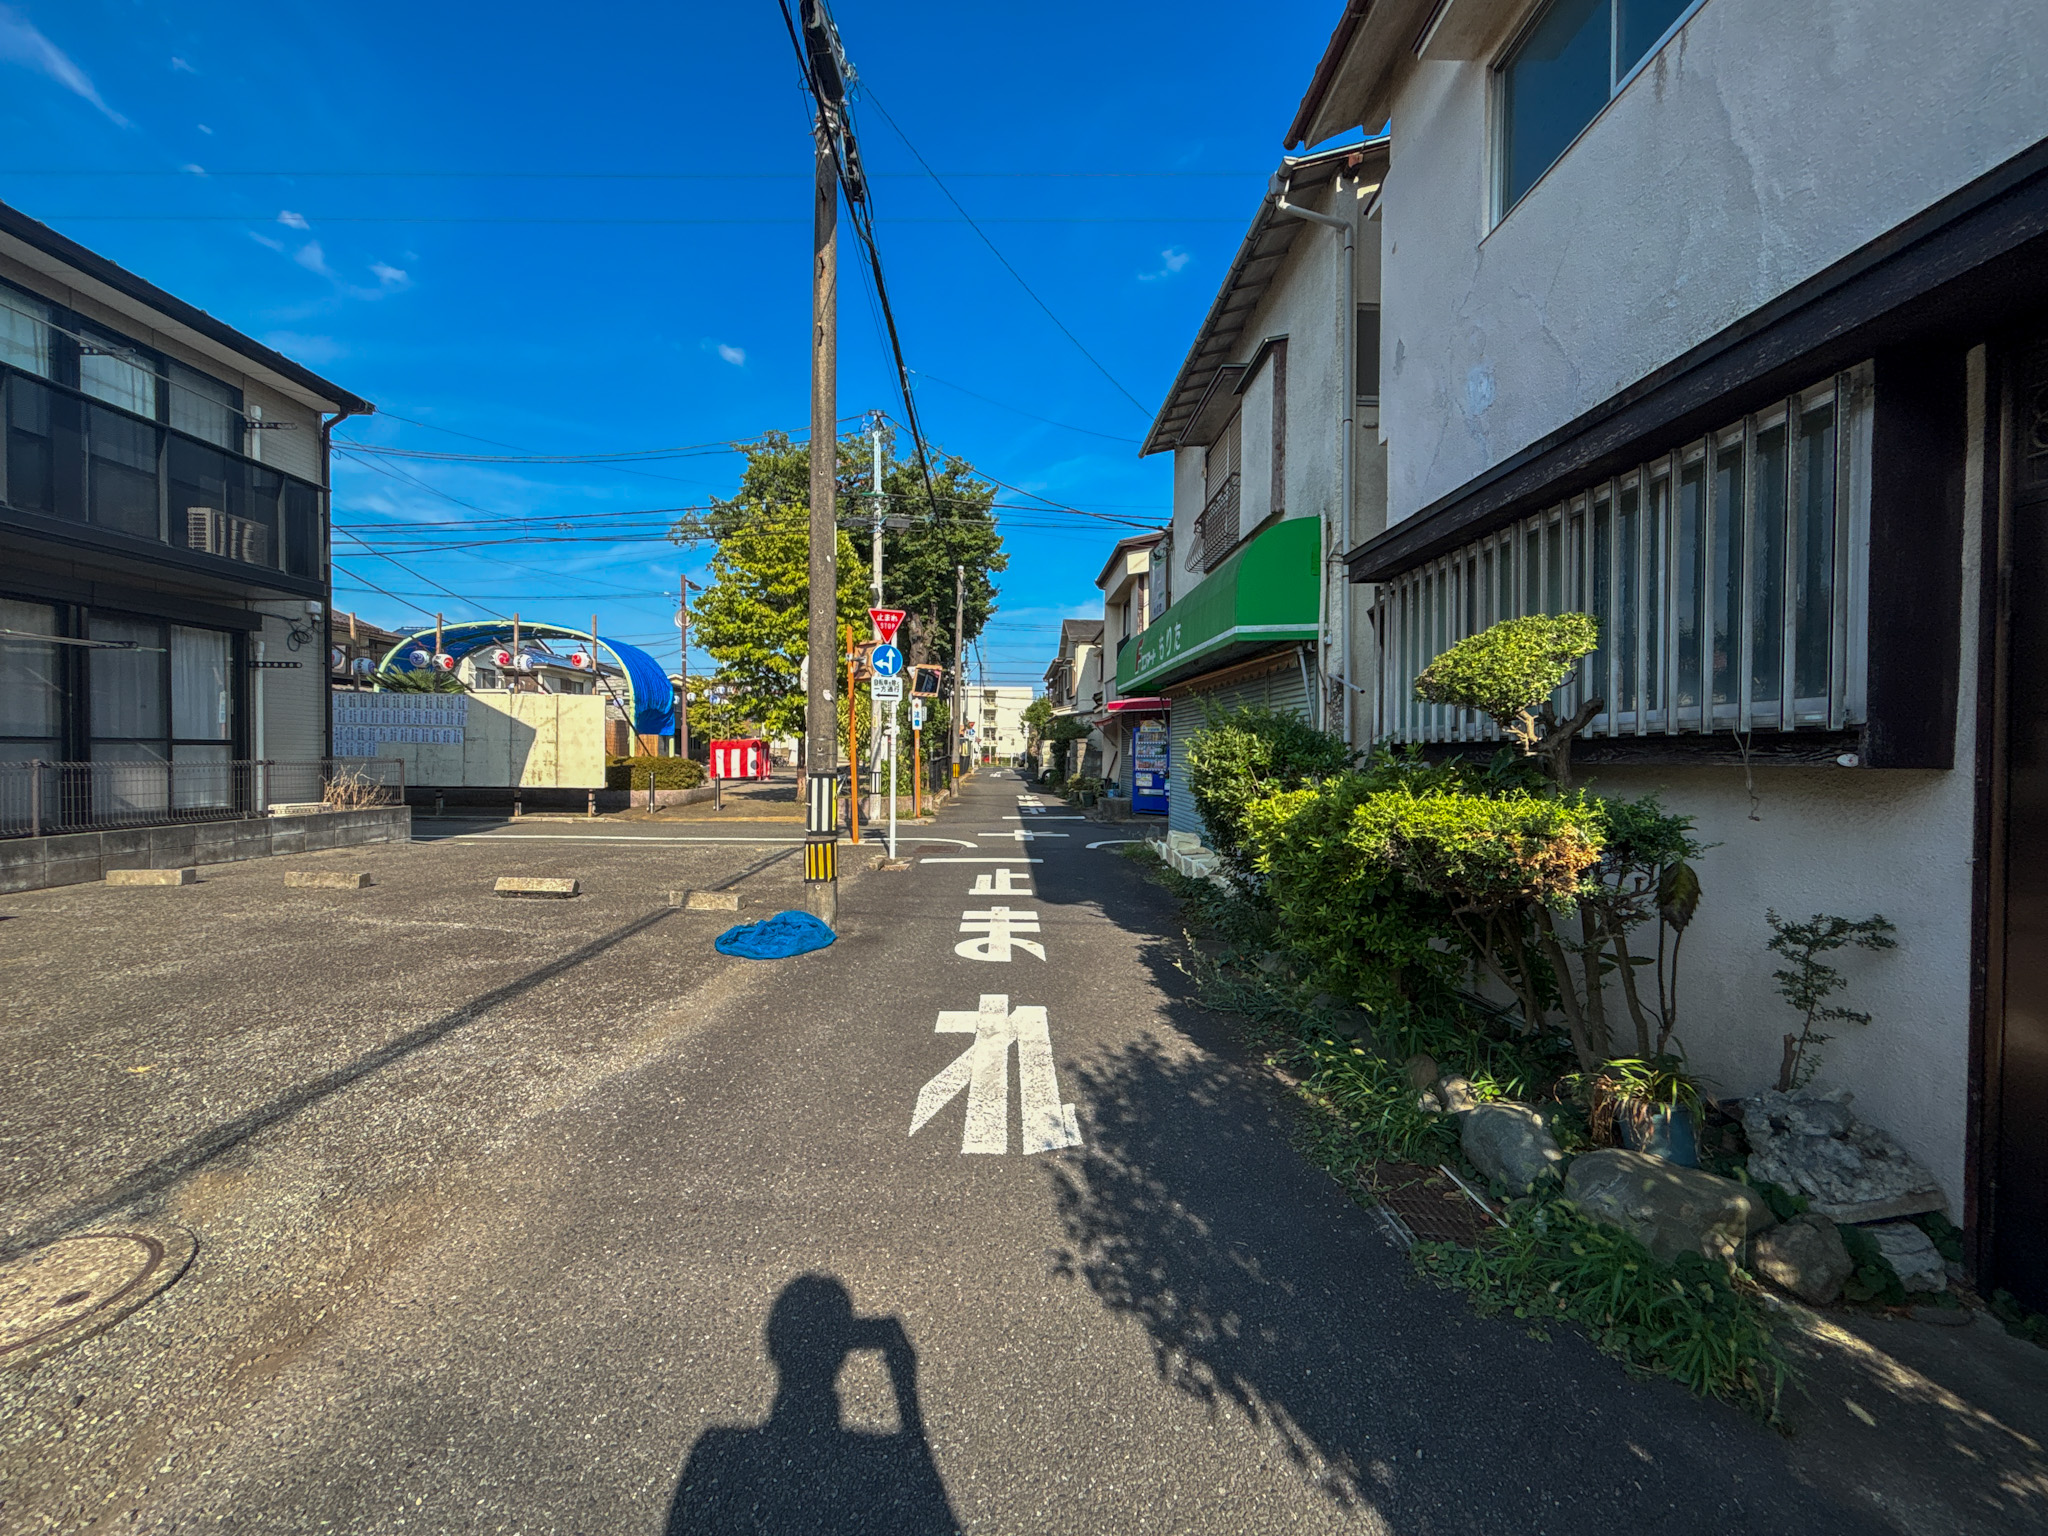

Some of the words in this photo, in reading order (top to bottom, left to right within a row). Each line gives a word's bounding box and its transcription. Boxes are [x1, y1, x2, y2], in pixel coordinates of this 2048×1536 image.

[876, 613, 898, 622] 止まれ
[880, 622, 896, 630] STOP
[908, 868, 1084, 1155] 止まれ
